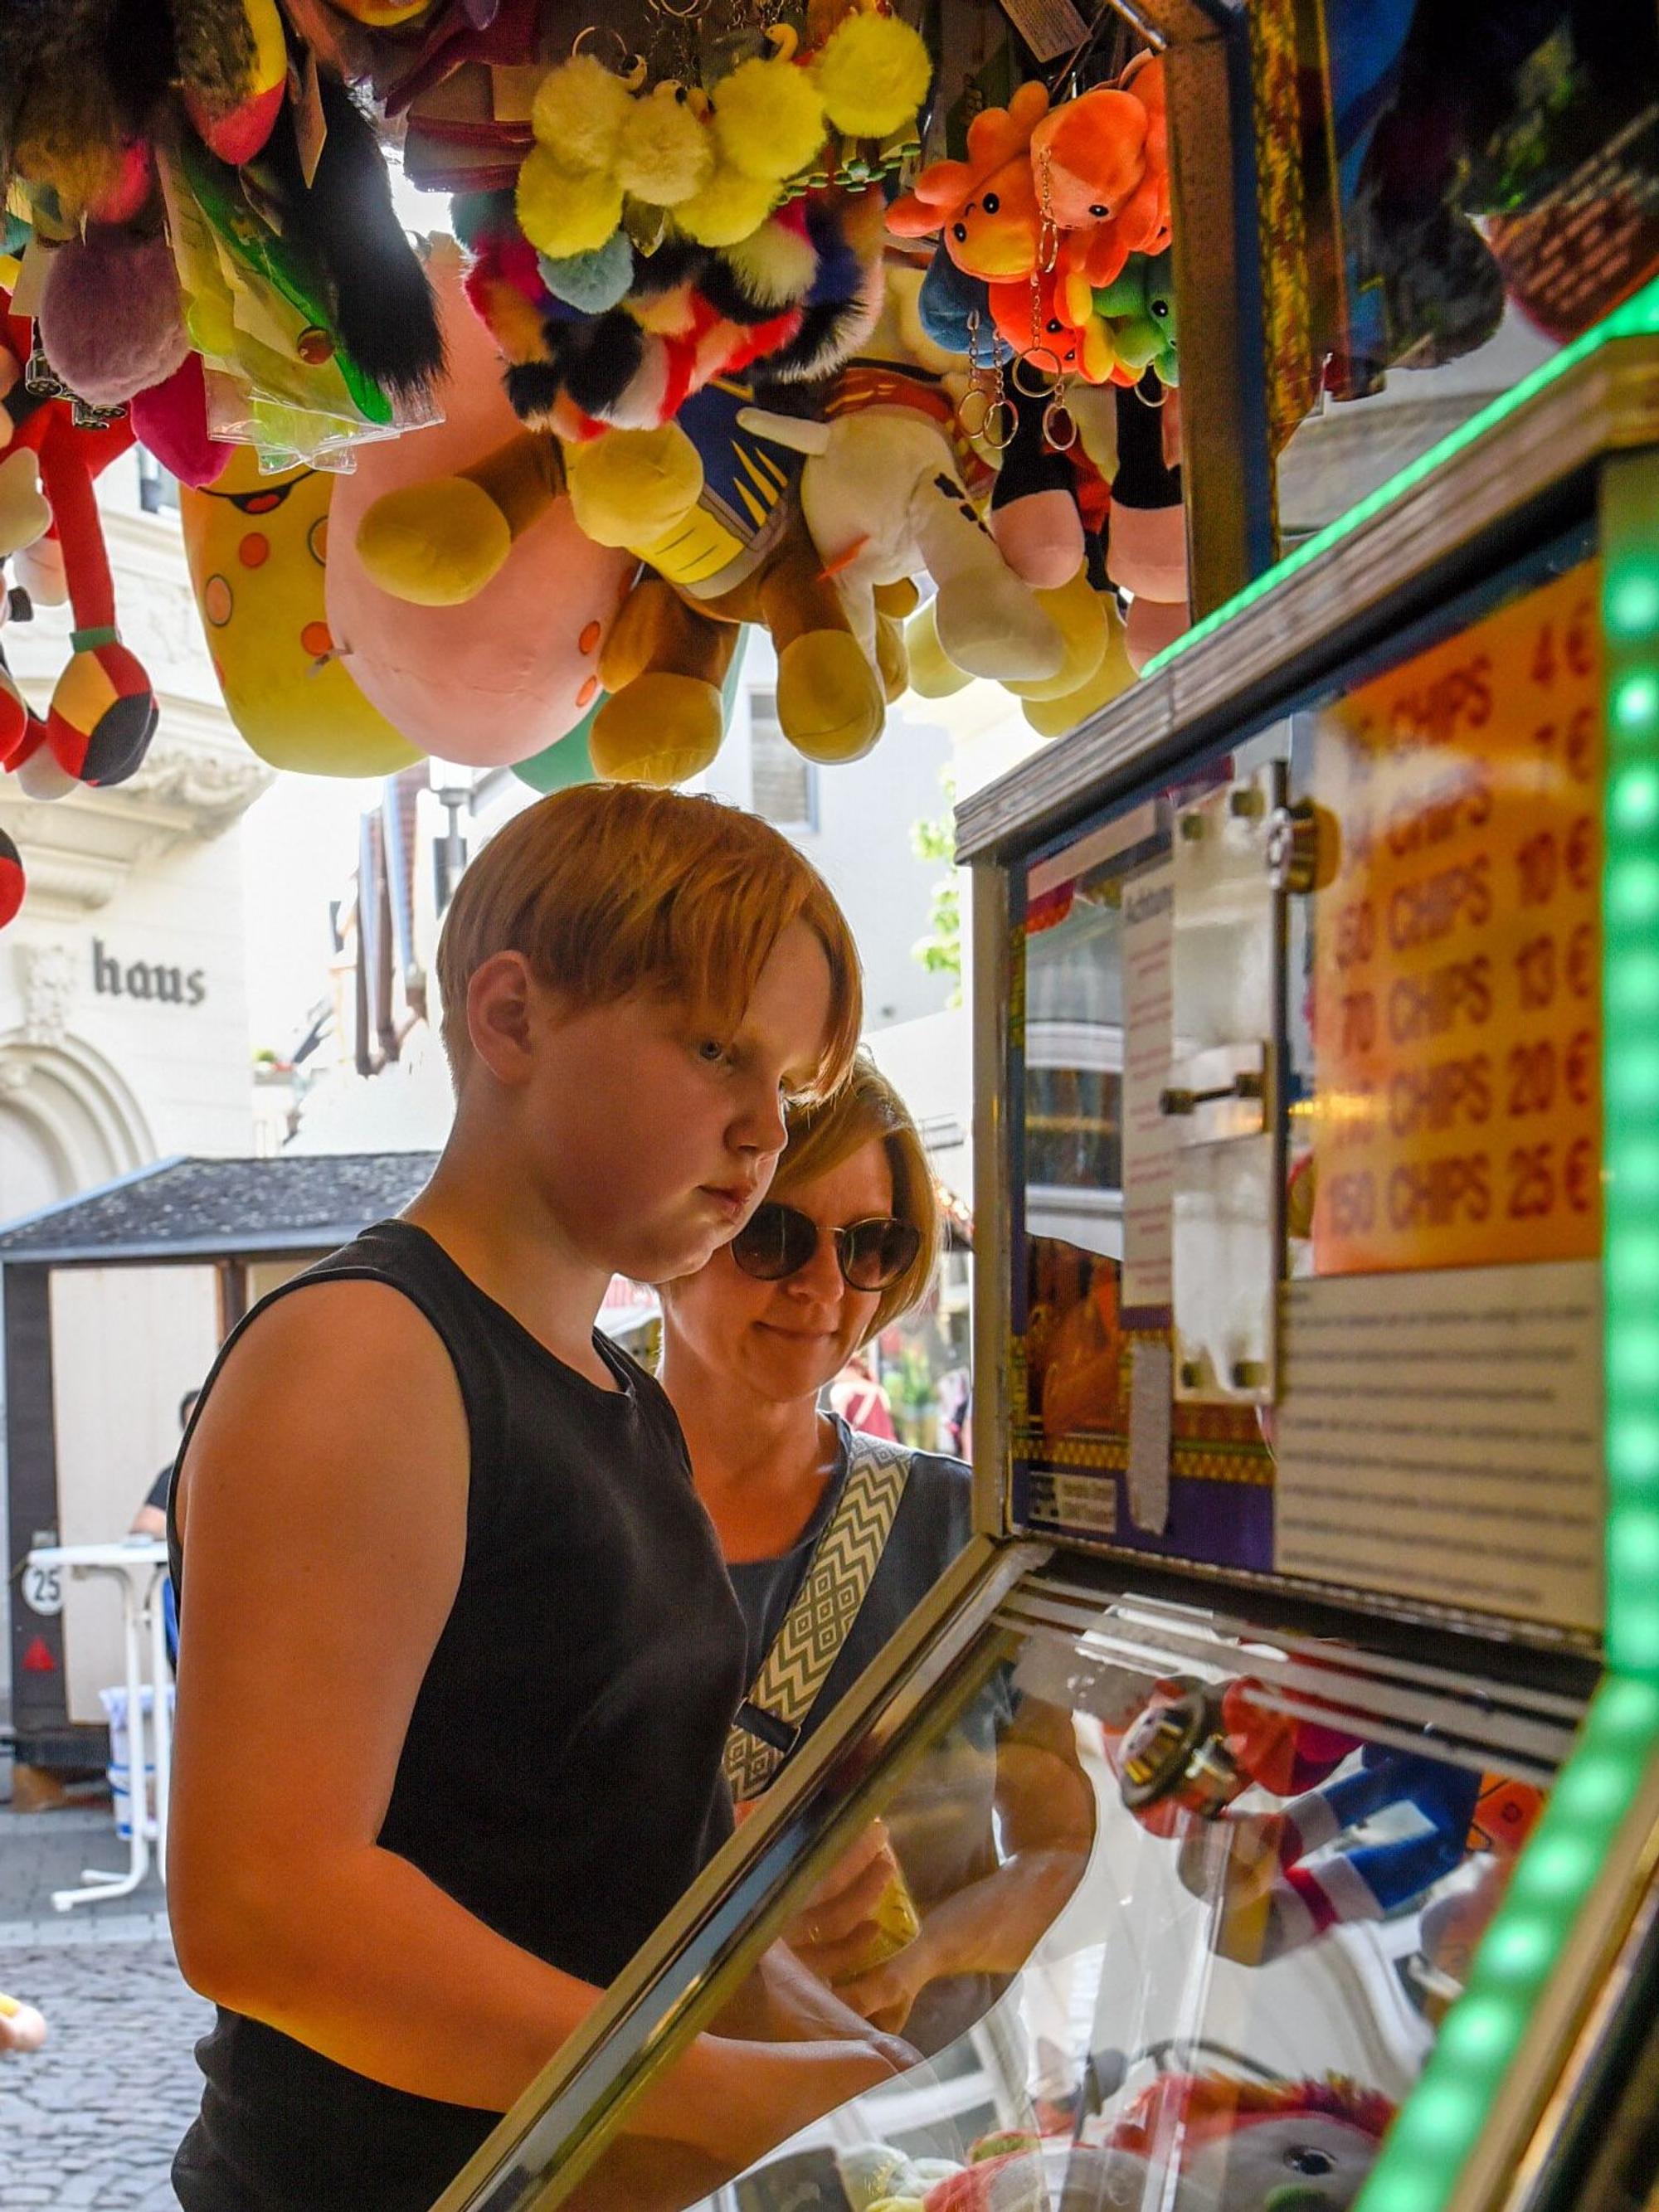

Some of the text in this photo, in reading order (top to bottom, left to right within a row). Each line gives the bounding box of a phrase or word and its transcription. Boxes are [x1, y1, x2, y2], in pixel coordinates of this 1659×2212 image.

[1387, 854, 1491, 951] CHIPS
[1564, 811, 1594, 896] €
[91, 935, 206, 1006] haus
[1388, 954, 1491, 1047] CHIPS
[1564, 921, 1594, 1000] €
[1388, 1052, 1491, 1140] CHIPS
[1508, 1039, 1557, 1118] 20
[1564, 1028, 1593, 1108] €
[1387, 1151, 1491, 1231] CHIPS
[1508, 1143, 1556, 1219] 25
[1564, 1137, 1593, 1213] €
[33, 1568, 61, 1602] 25
